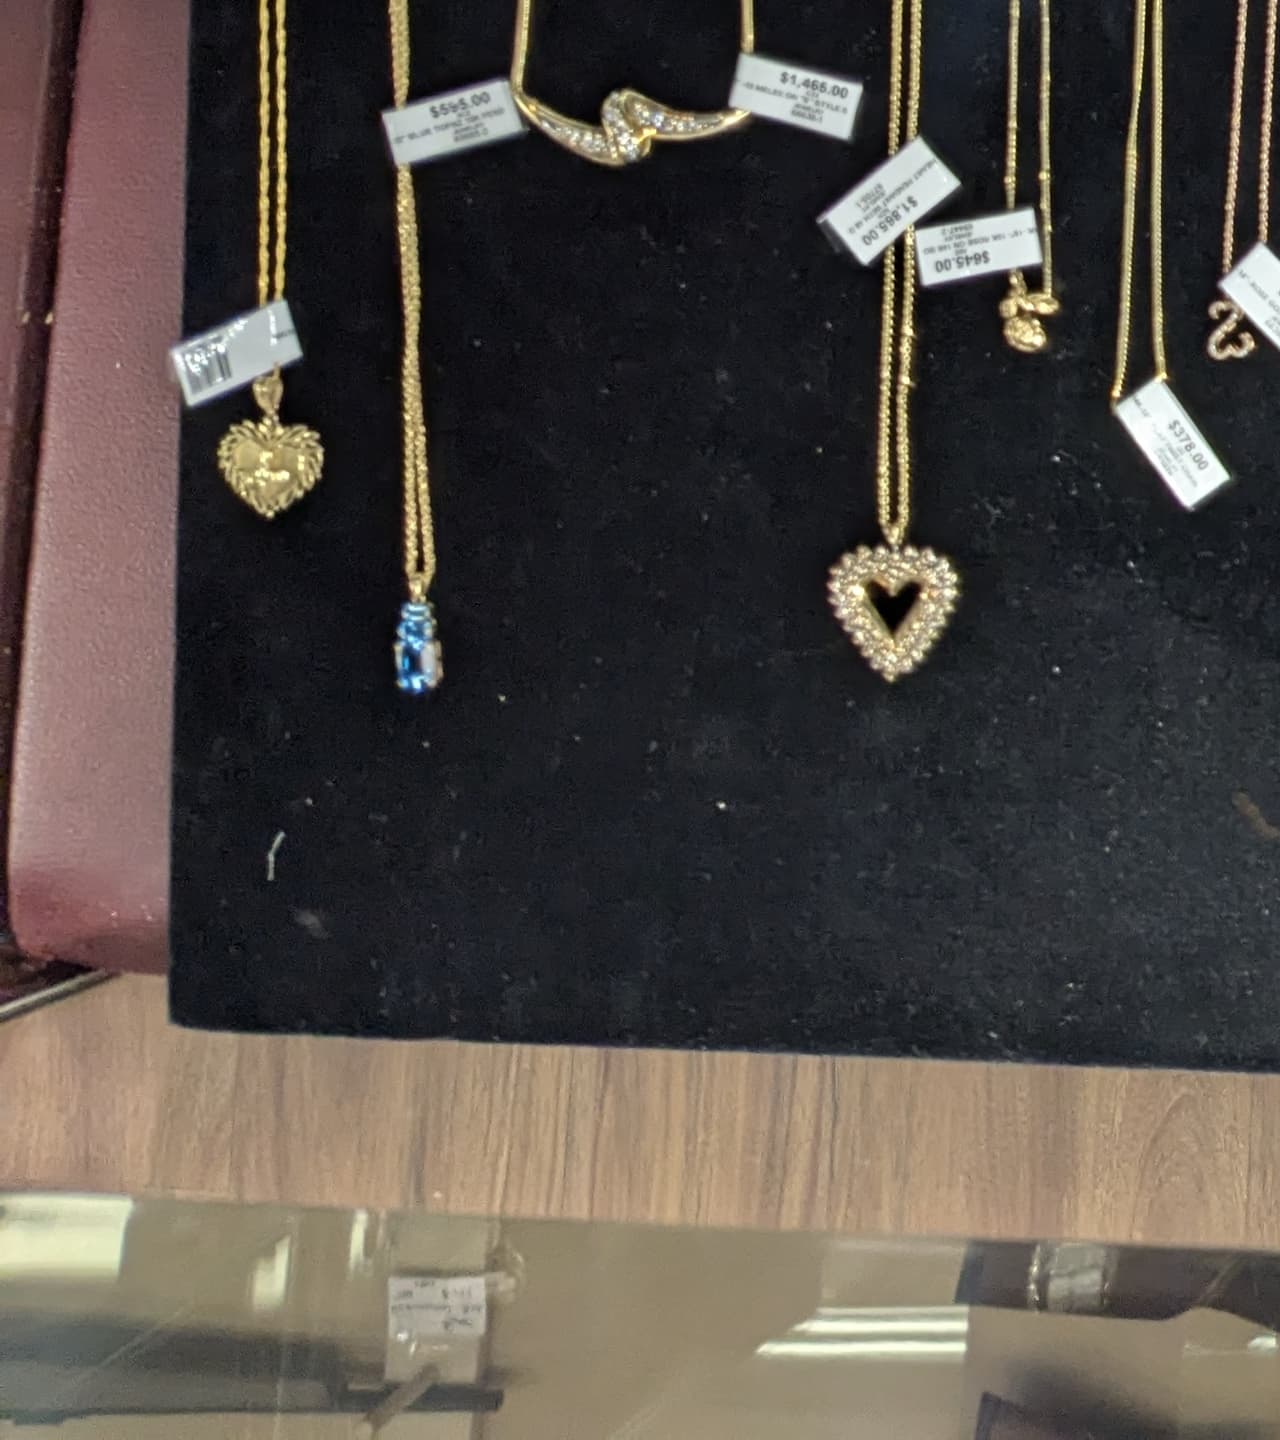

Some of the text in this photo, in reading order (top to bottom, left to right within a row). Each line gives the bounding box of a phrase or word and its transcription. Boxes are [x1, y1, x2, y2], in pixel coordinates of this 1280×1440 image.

[779, 71, 849, 99] $1,465.00
[860, 194, 919, 247] $1,865.00
[935, 250, 990, 272] $645.00
[1165, 417, 1210, 472] $378.00
